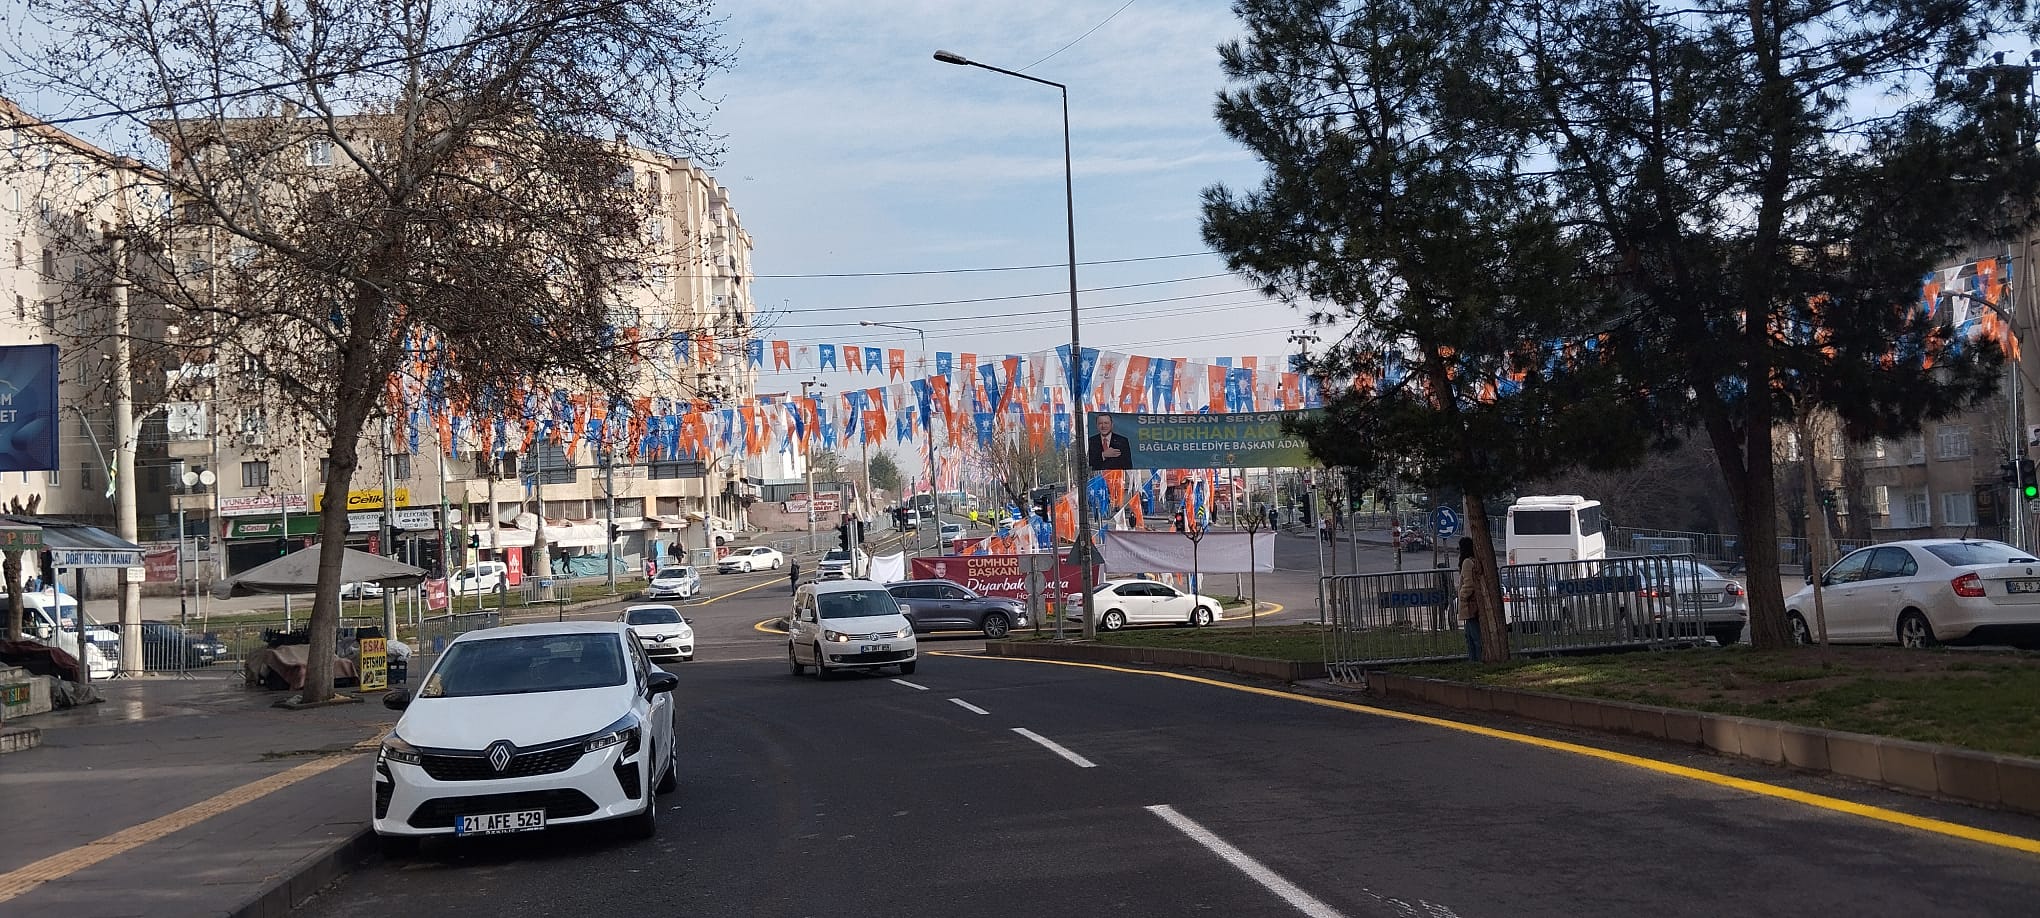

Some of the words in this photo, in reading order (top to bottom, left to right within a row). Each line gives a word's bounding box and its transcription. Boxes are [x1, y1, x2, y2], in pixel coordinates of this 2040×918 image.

[1138, 415, 1165, 424] SER
[1168, 415, 1219, 424] SERAN
[1225, 415, 1253, 423] SER
[1139, 441, 1180, 452] BAĞLAR
[1182, 440, 1230, 451] BELEDİYE
[1233, 440, 1275, 451] BAŞKAN
[84, 552, 109, 564] MEVSİM
[967, 557, 1018, 568] CUMHUR
[969, 566, 1022, 577] BAŞKANI
[362, 656, 386, 669] PETSHOP
[464, 817, 479, 831] 21
[487, 814, 511, 829] AFE
[517, 812, 541, 826] 529
